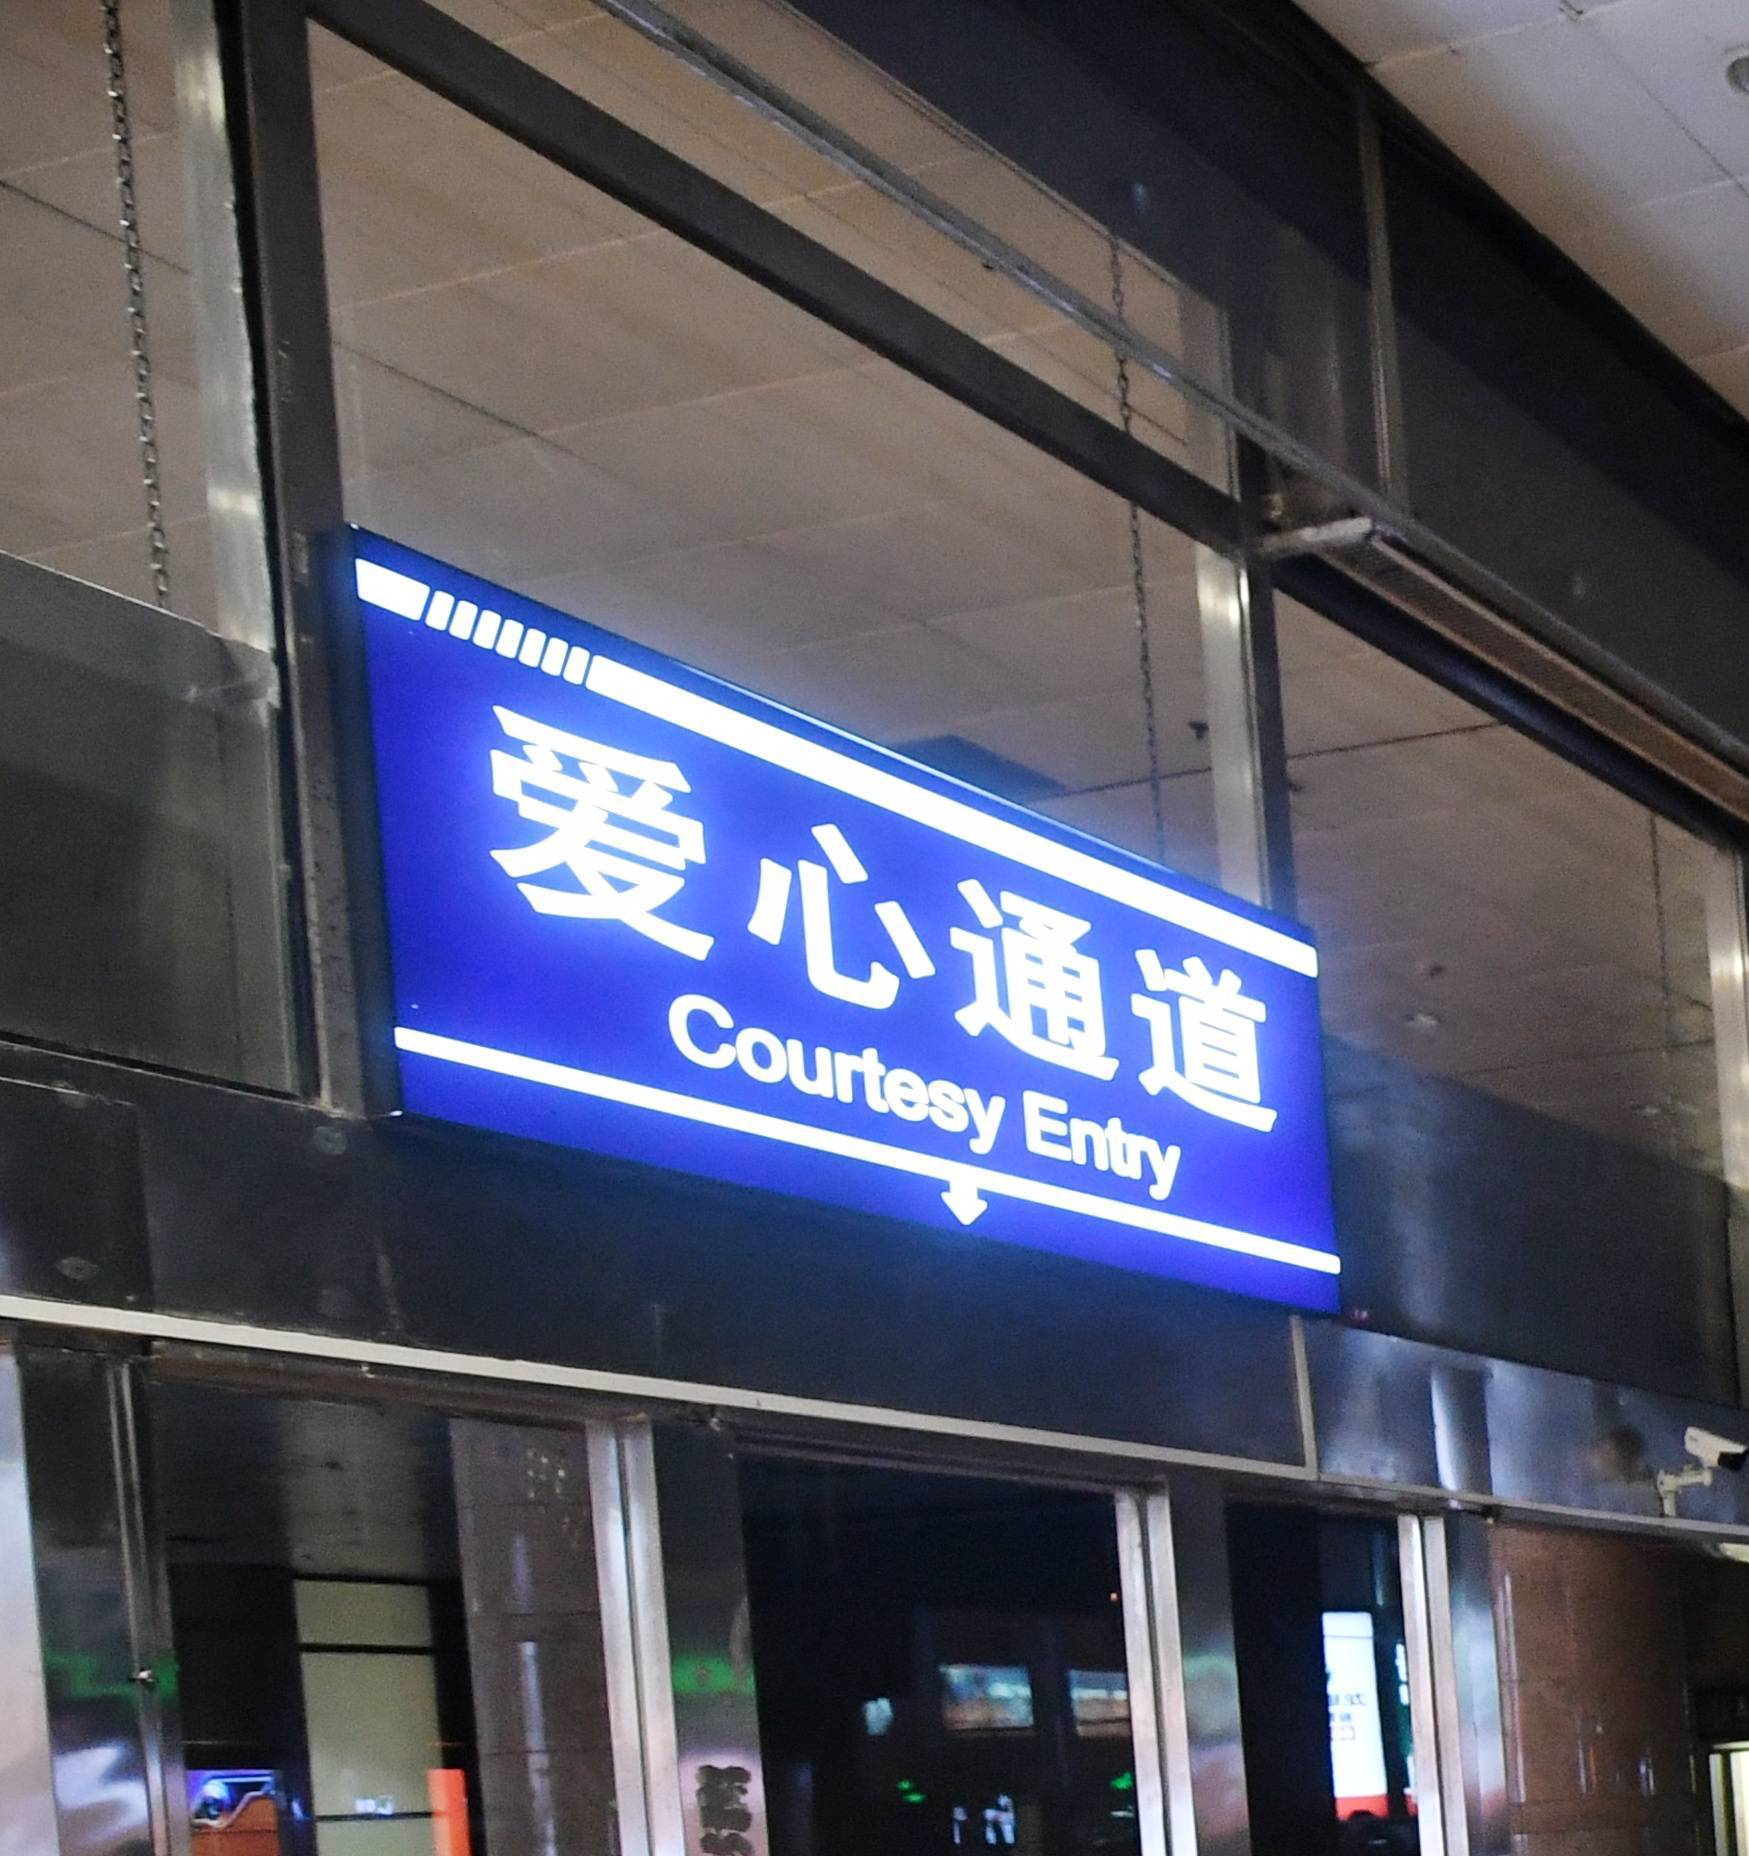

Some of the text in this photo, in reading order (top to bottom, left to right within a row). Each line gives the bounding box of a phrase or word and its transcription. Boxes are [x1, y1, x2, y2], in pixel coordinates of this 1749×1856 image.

[489, 703, 1277, 1132] 爱心通道
[668, 993, 1183, 1200] Courtesy Entry
